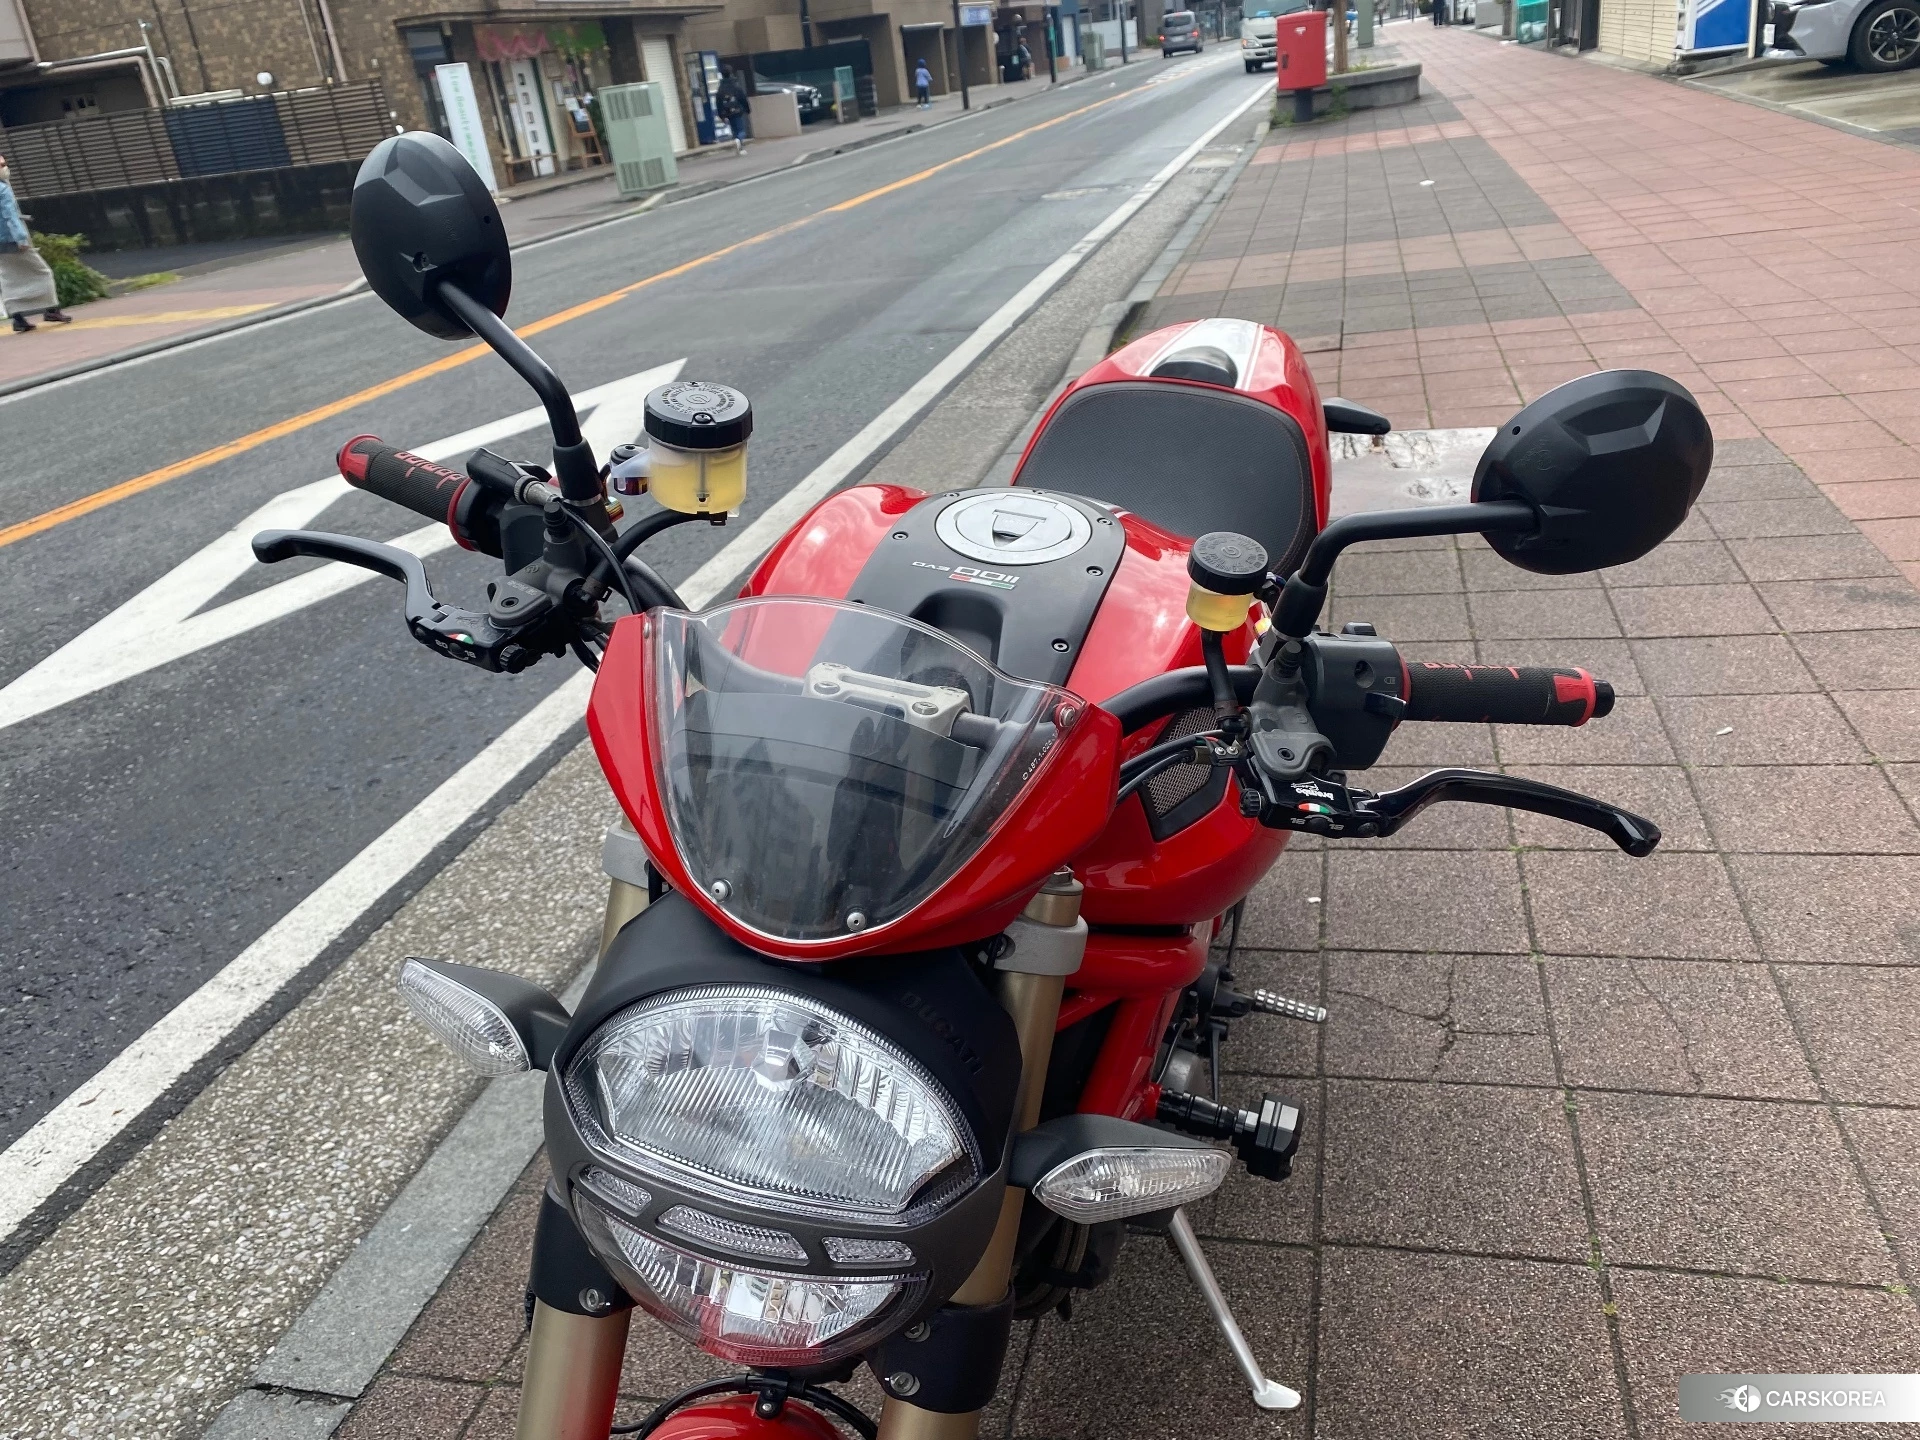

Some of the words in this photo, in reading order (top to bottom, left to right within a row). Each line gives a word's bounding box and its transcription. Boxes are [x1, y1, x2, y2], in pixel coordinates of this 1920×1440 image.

[911, 561, 951, 572] EVO
[952, 565, 1020, 584] 1100
[1295, 787, 1334, 801] brembo
[900, 992, 984, 1076] DUCATI
